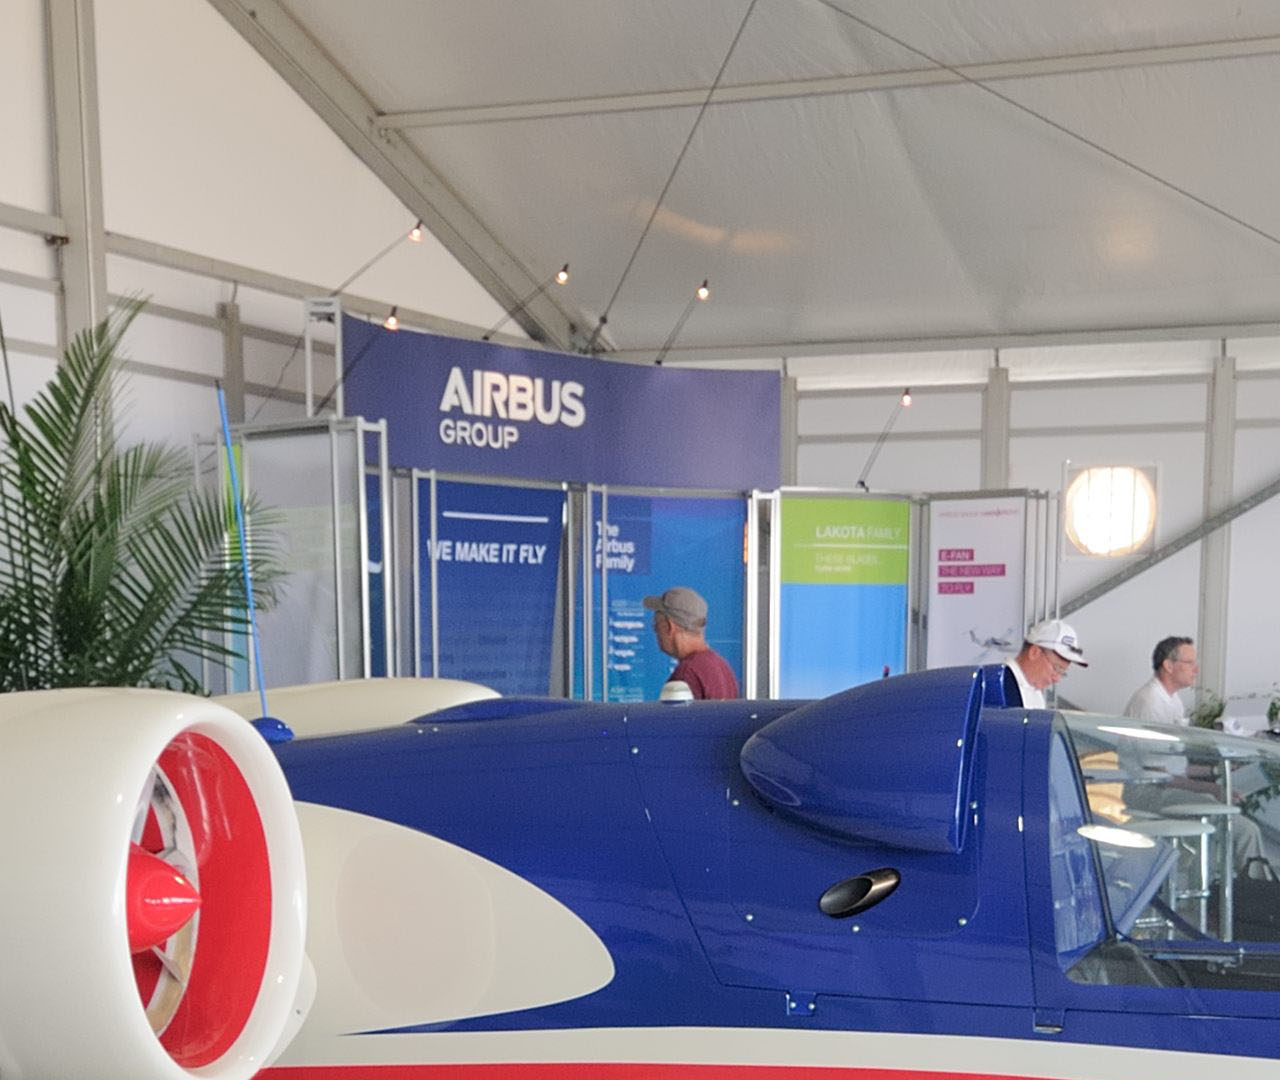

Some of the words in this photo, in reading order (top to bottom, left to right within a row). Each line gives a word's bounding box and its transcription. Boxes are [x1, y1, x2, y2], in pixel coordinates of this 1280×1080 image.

[439, 366, 586, 428] AIRBUS
[439, 418, 519, 449] GROUP
[455, 541, 499, 564] MAKE
[501, 543, 518, 564] IT
[519, 543, 547, 565] FLY
